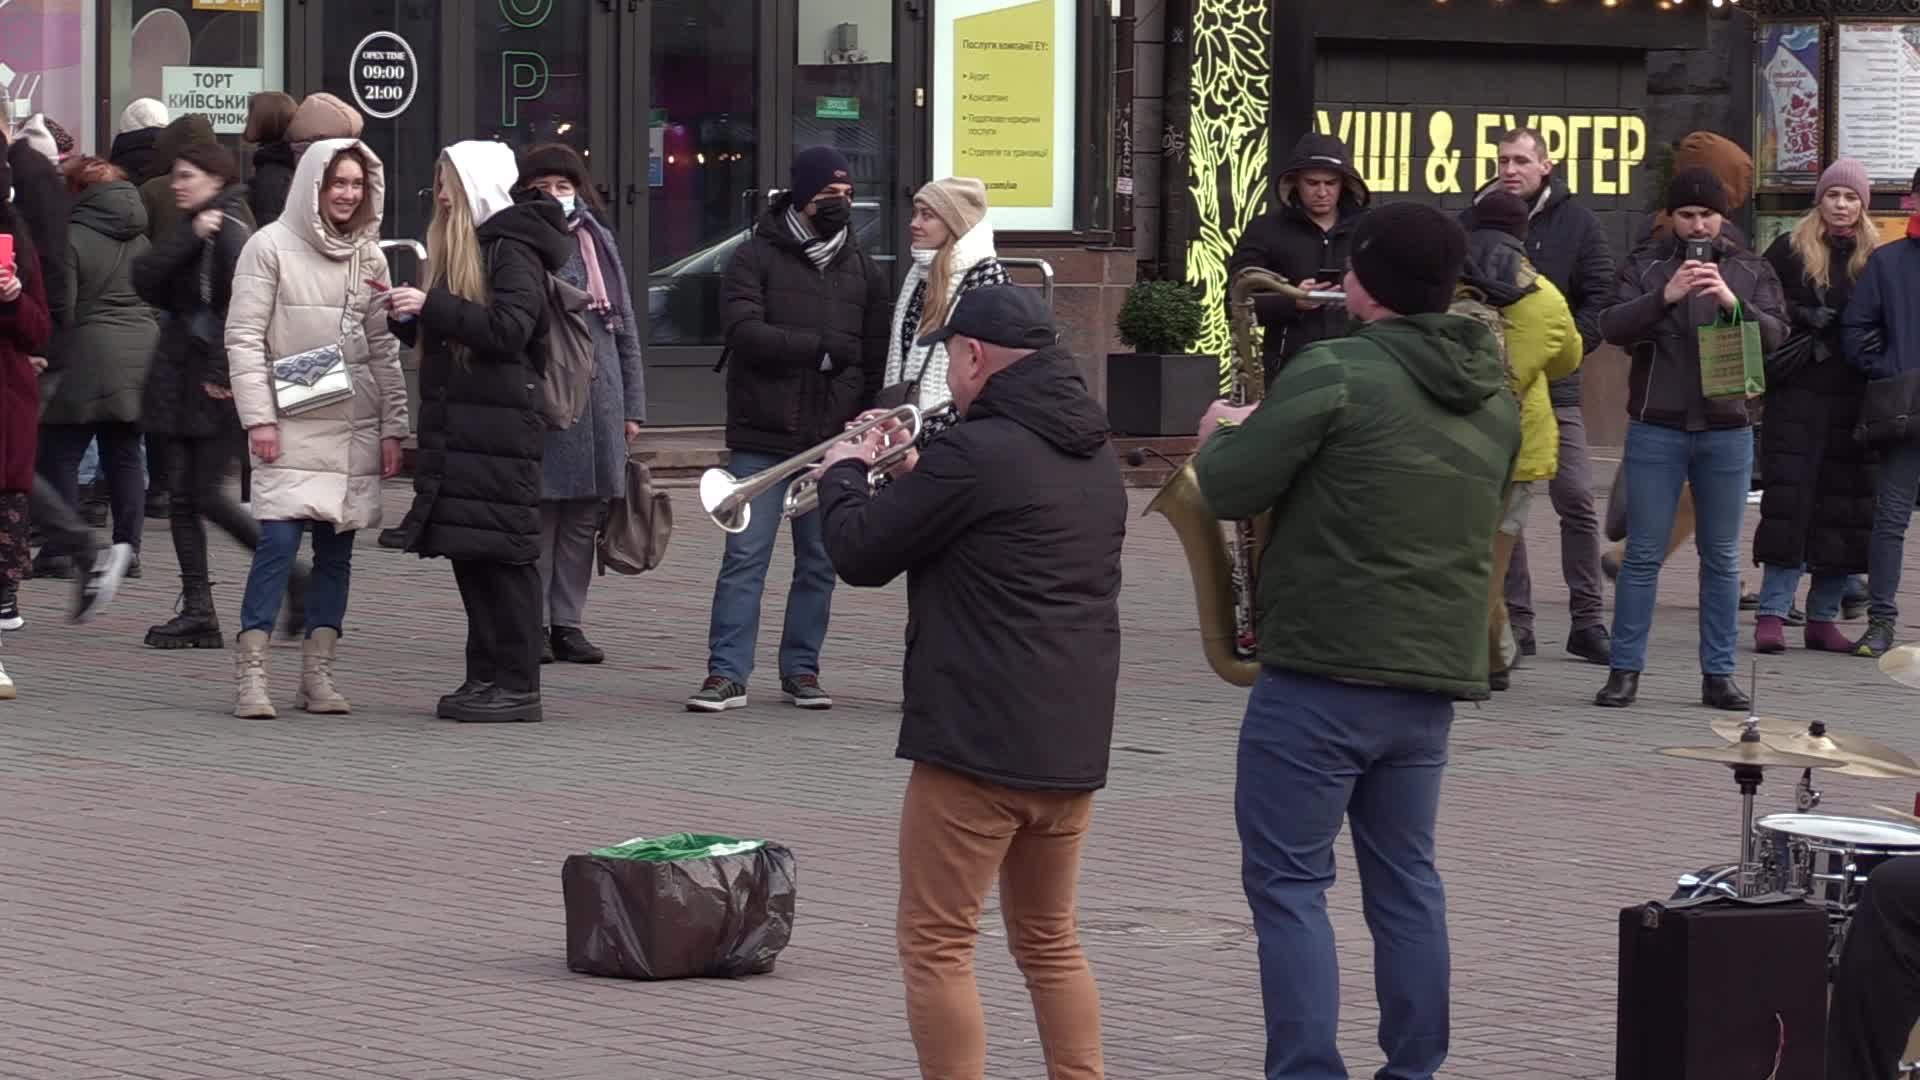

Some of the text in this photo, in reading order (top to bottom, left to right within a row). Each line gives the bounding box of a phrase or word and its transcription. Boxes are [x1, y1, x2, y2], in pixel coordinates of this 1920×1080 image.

[192, 72, 233, 89] ТОРТ
[362, 65, 405, 80] 09:00
[168, 89, 257, 109] КИЇВСЬКИ
[364, 85, 403, 100] 21:00
[1475, 112, 1647, 195] БРГЕР
